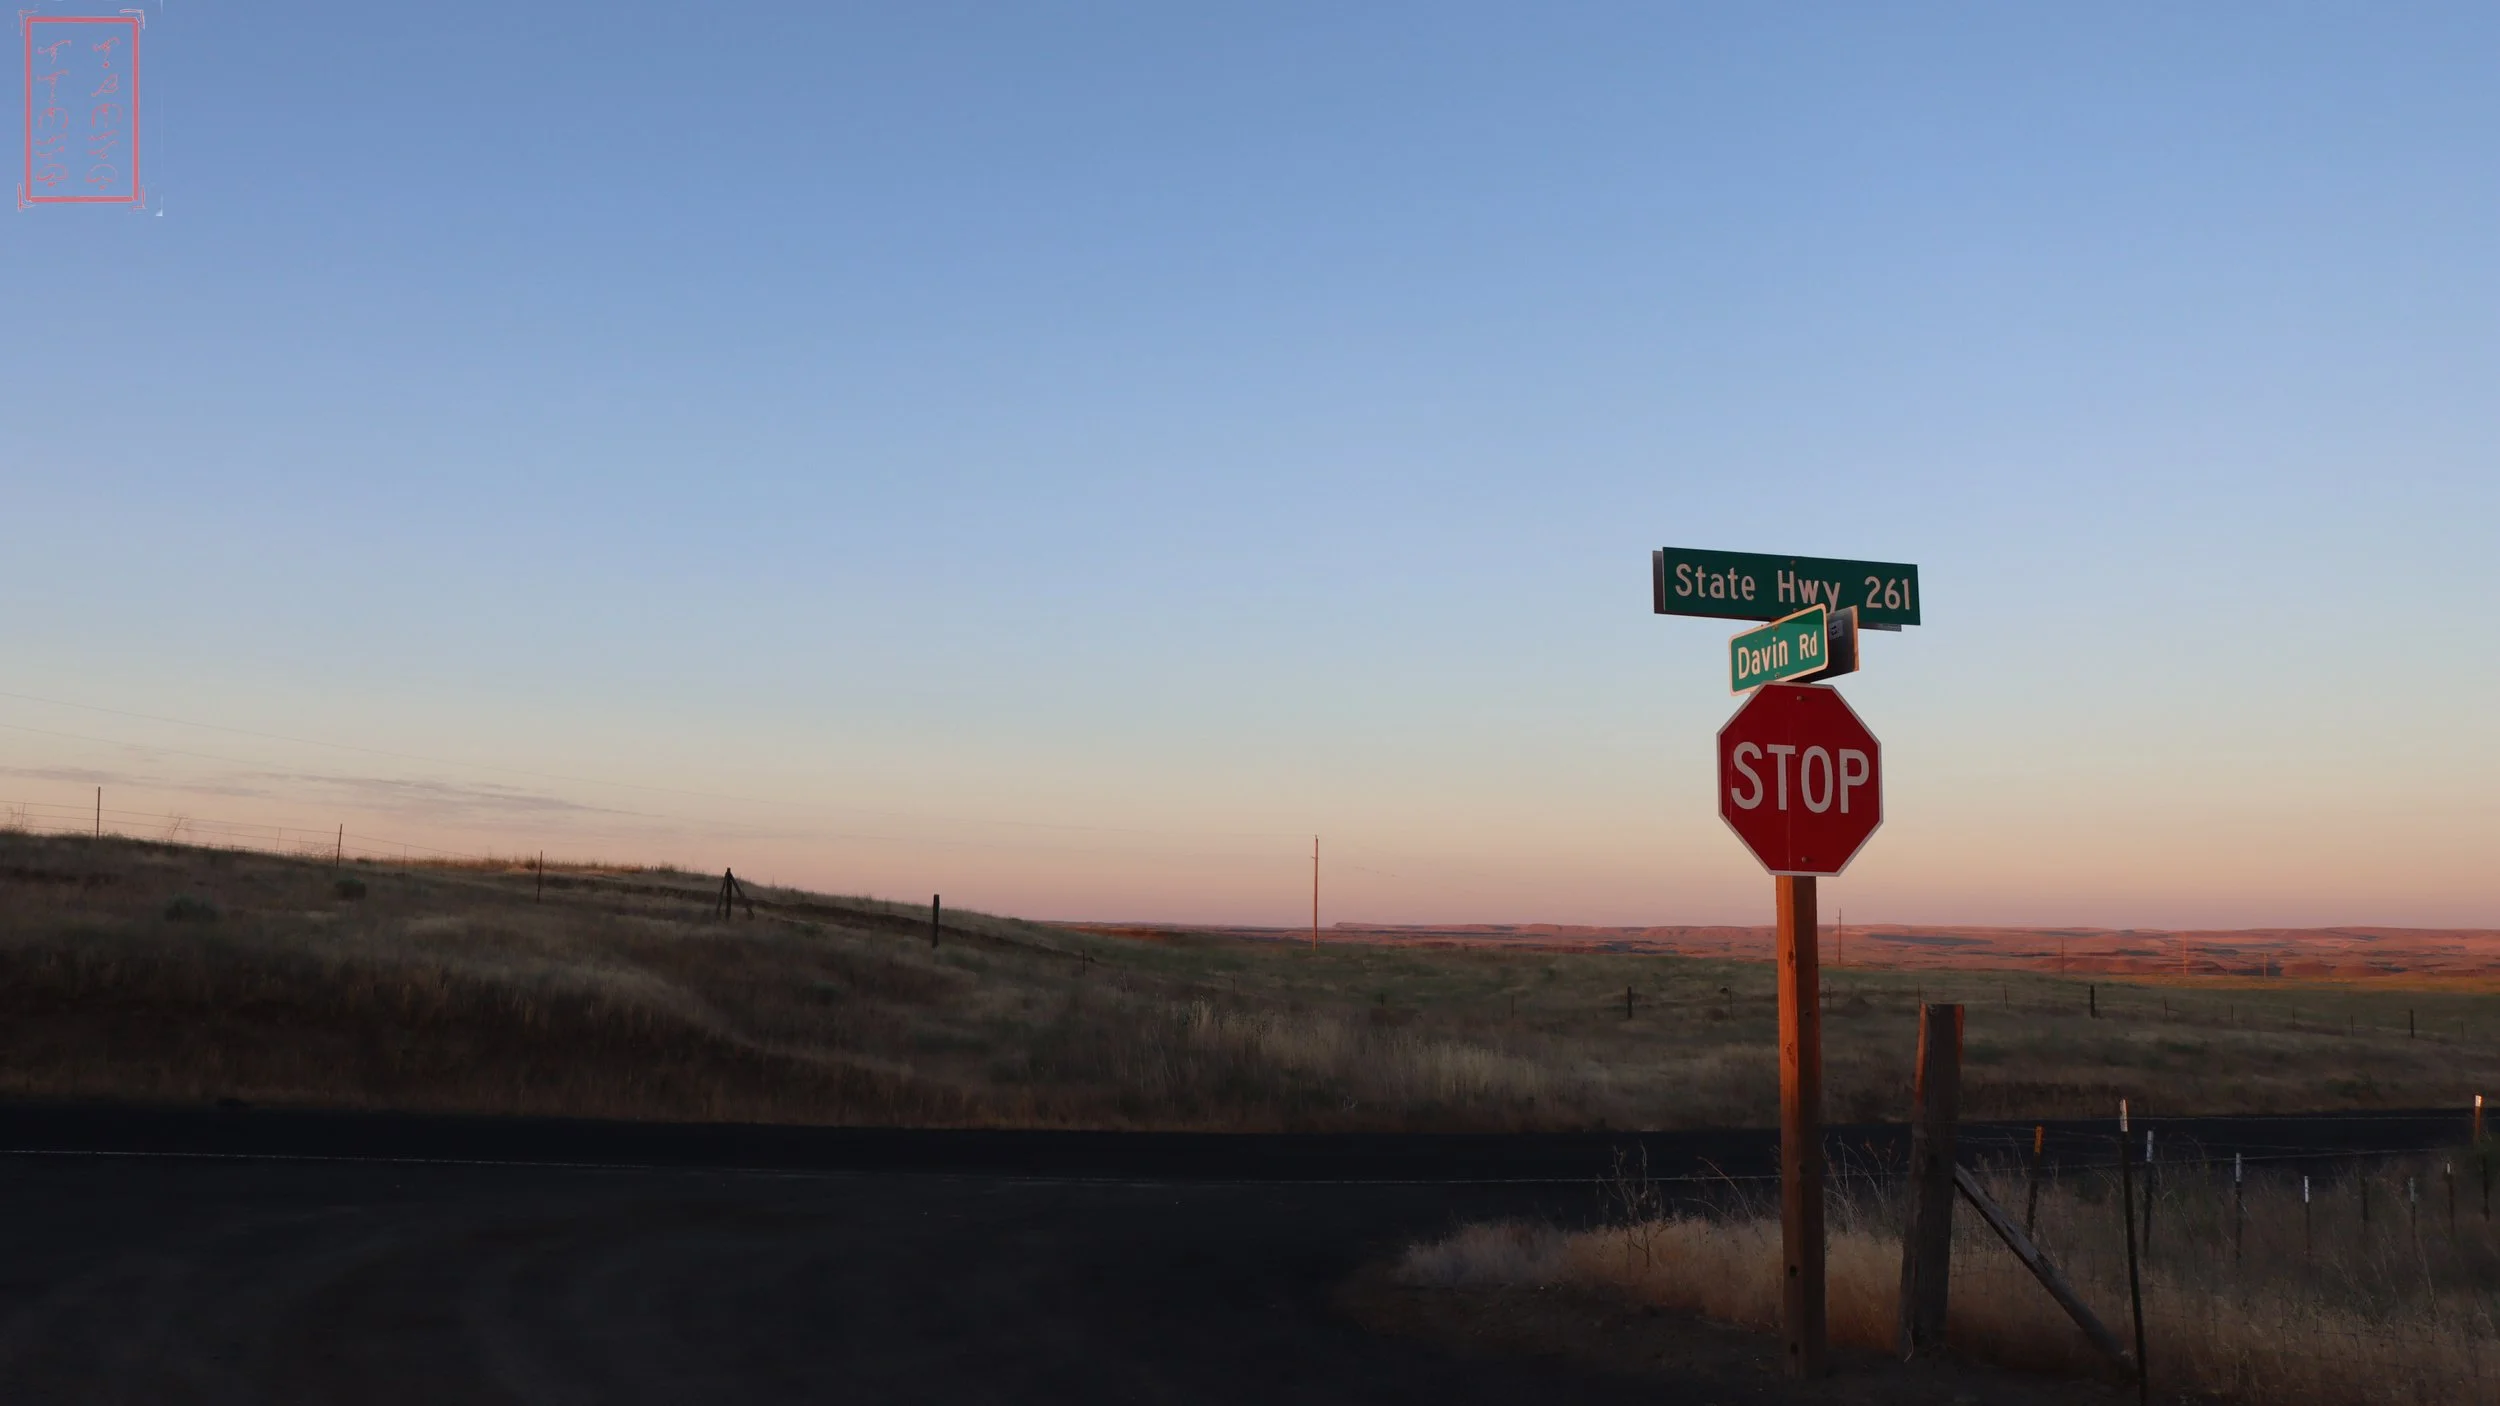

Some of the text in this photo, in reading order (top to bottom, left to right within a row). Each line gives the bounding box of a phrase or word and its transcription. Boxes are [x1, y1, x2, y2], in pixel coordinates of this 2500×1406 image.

[1675, 563, 1910, 614] State Hwy 261
[1738, 637, 1788, 679] Davin
[1799, 631, 1818, 660] Rd
[1731, 741, 1870, 814] STOP
